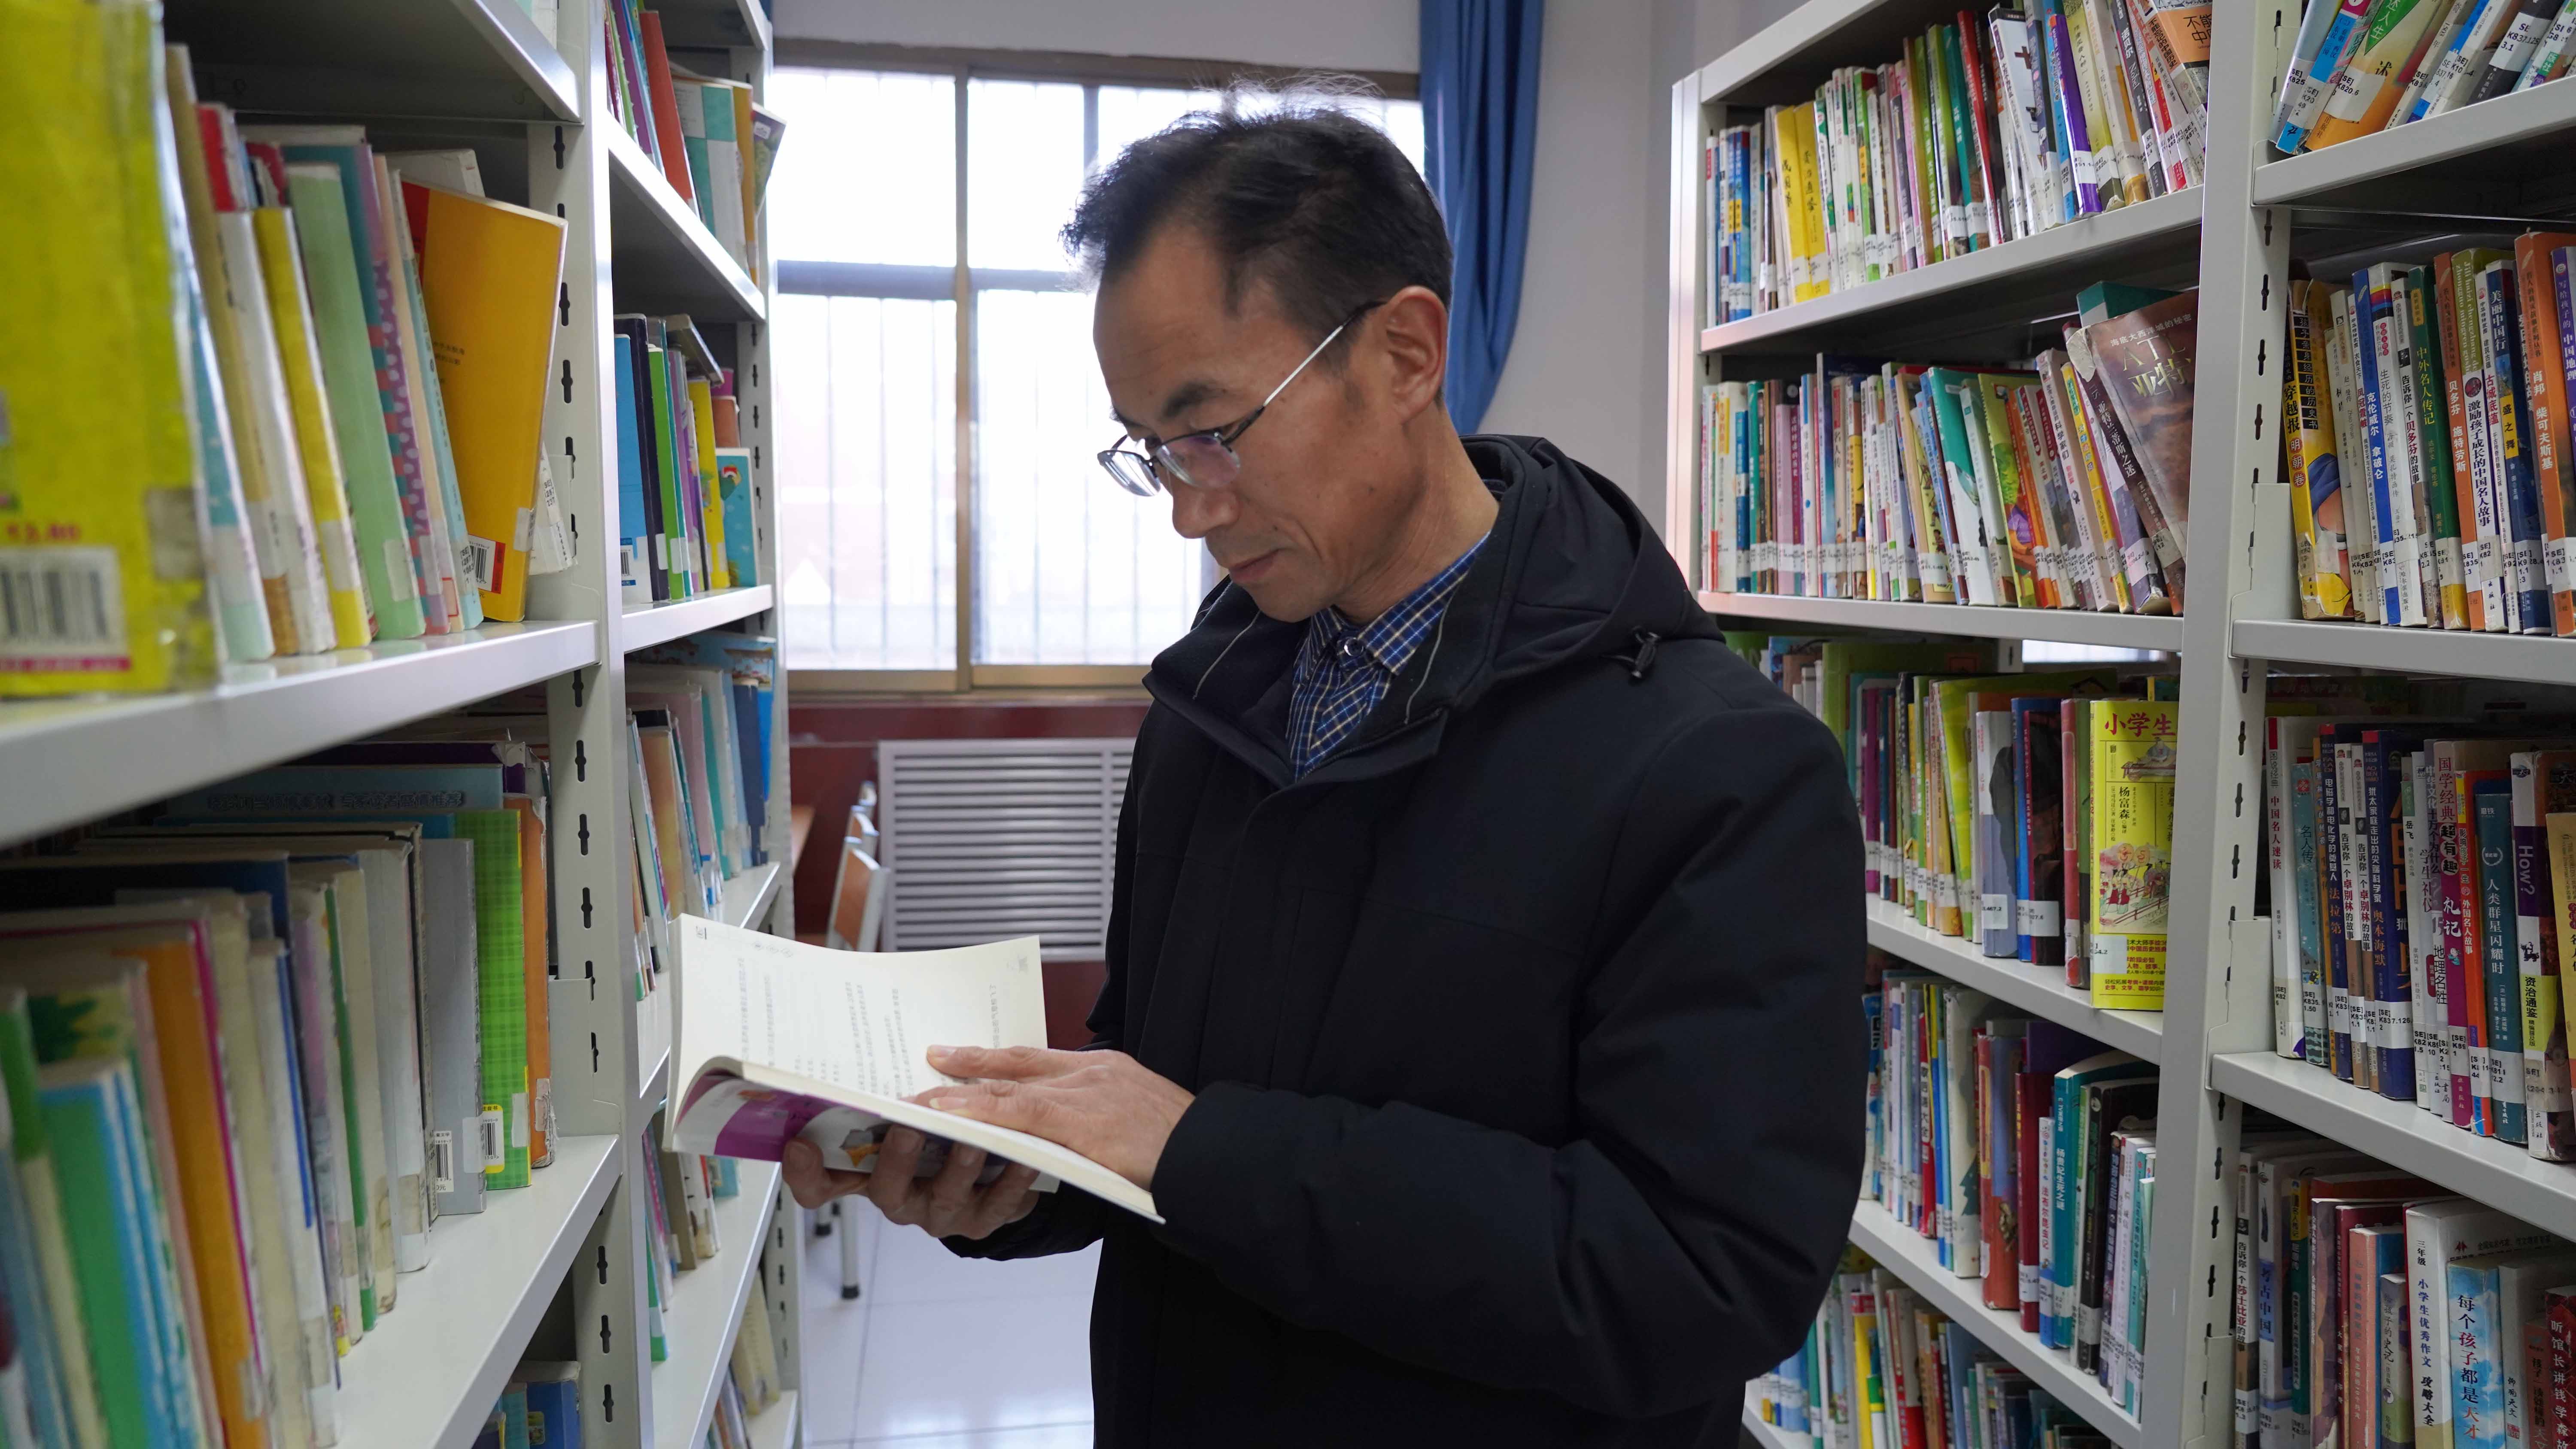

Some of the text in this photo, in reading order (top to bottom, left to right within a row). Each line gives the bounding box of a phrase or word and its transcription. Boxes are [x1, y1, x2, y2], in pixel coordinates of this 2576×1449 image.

[2129, 61, 2140, 90] Nobel
[2490, 291, 2506, 350] 美丽中国行
[2558, 279, 2576, 381] 写给孩子的 中国地理
[2284, 385, 2300, 433] 穿越报
[2379, 370, 2394, 426] 生死的节奏
[2416, 347, 2436, 425] 中外名人传记
[2485, 374, 2499, 426] 古城底蕴
[2366, 392, 2384, 480] 克伦威尔 拿破仑
[2402, 374, 2420, 484] 告诉你一个贝多芬的故事
[2448, 381, 2466, 472] 贝多芬 施特劳斯
[2533, 370, 2555, 470] 肖邦 柴可夫斯基
[2290, 437, 2306, 488] 明朝卷
[2468, 401, 2491, 527] 激励孩子成长的中国名人故事
[2105, 712, 2176, 737] 小学生
[2119, 786, 2130, 819] 杨富森
[2438, 757, 2456, 821] 国学经典
[2270, 796, 2282, 870] 中国名人速读
[2301, 825, 2316, 864] 名人传
[2406, 821, 2415, 840] 岳飞
[2440, 824, 2459, 875] 超有趣
[2341, 833, 2354, 940] 告诉你一个卓别林的故事
[2357, 843, 2371, 952] 告诉你一个卓别林的故事
[2518, 845, 2535, 896] How?
[2329, 888, 2342, 934] 法拉第
[2372, 909, 2386, 967] 奥本海默
[2443, 897, 2462, 937] 礼记
[2462, 899, 2473, 954] 外国名人故事
[2433, 944, 2448, 1005] 地理名胜
[2525, 976, 2539, 1019] 资治通鉴
[2379, 1009, 2391, 1017] [SE]
[2416, 1240, 2435, 1427] 三年级 小学生优秀作文 攻略大全
[2458, 1295, 2480, 1439] 每个孩子都是天才
